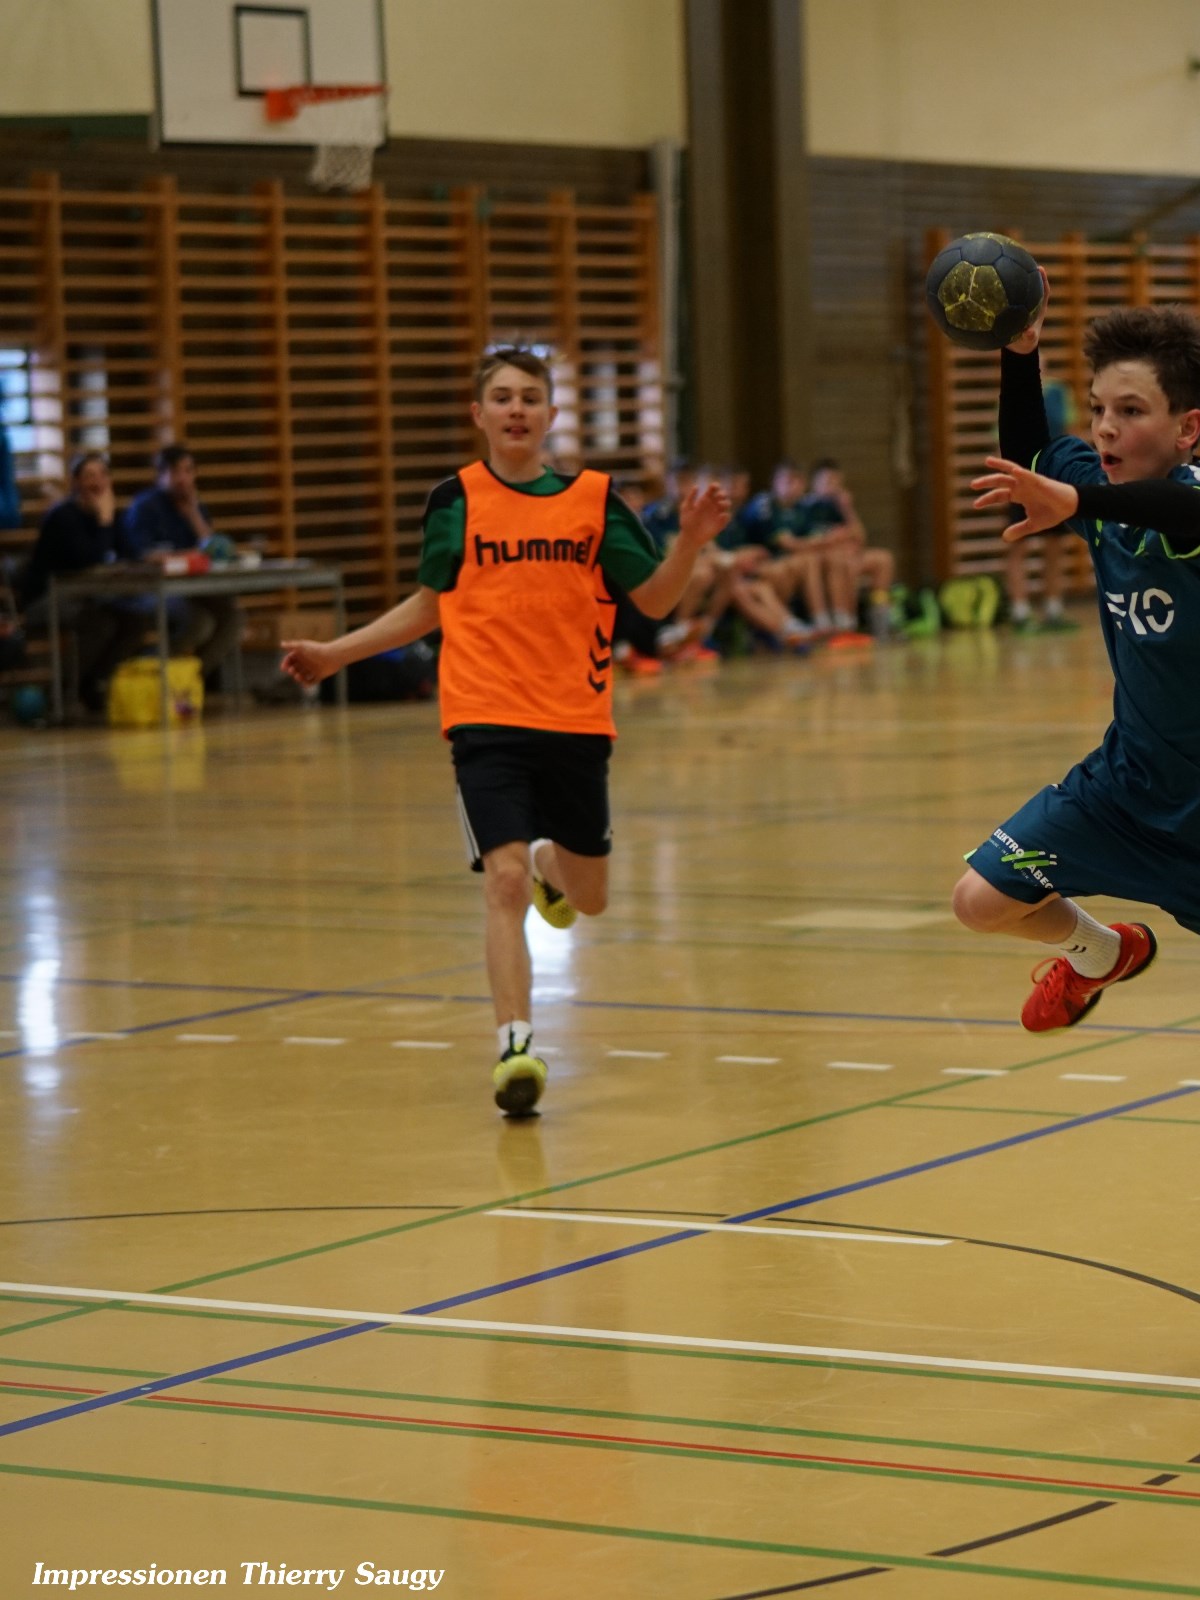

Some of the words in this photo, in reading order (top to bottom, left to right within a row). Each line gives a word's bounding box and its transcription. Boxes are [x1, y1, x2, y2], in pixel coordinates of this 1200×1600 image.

[475, 534, 595, 573] hummel
[1104, 587, 1175, 635] EKO
[993, 828, 1025, 857] ELEKTRO
